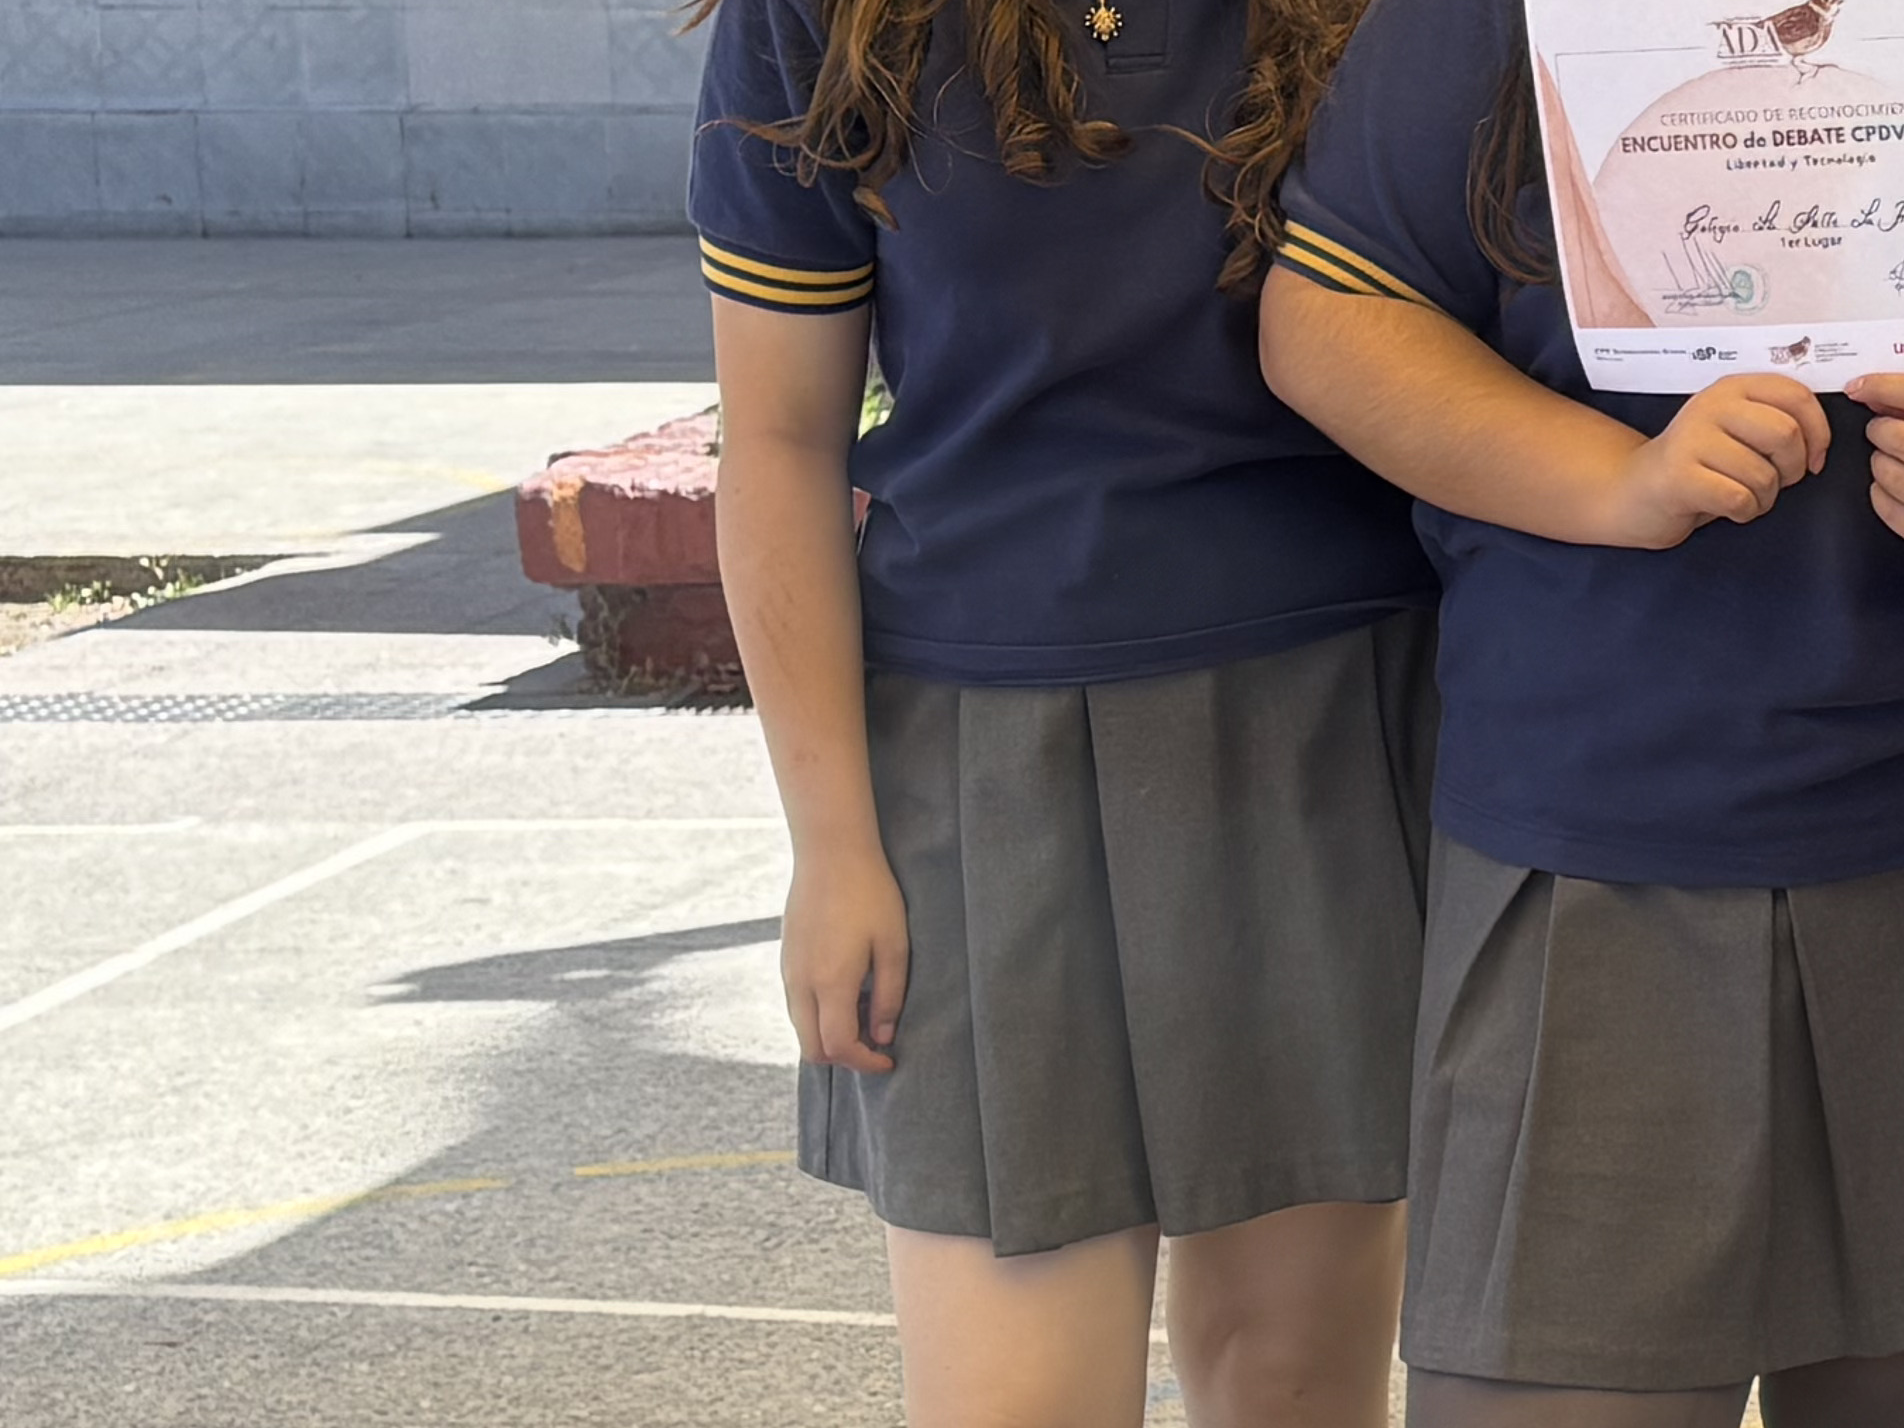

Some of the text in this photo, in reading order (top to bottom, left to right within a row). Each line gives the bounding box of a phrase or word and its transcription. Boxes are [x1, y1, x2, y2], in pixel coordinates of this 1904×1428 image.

[1660, 109, 1758, 127] CERTIFICADO
[1763, 108, 1785, 122] DE
[1621, 132, 1738, 154] ENCUENTRO
[1743, 131, 1766, 149] de
[1772, 126, 1846, 148] DEBATE
[1790, 158, 1798, 171] y
[1780, 236, 1842, 250] 1er Lugar
